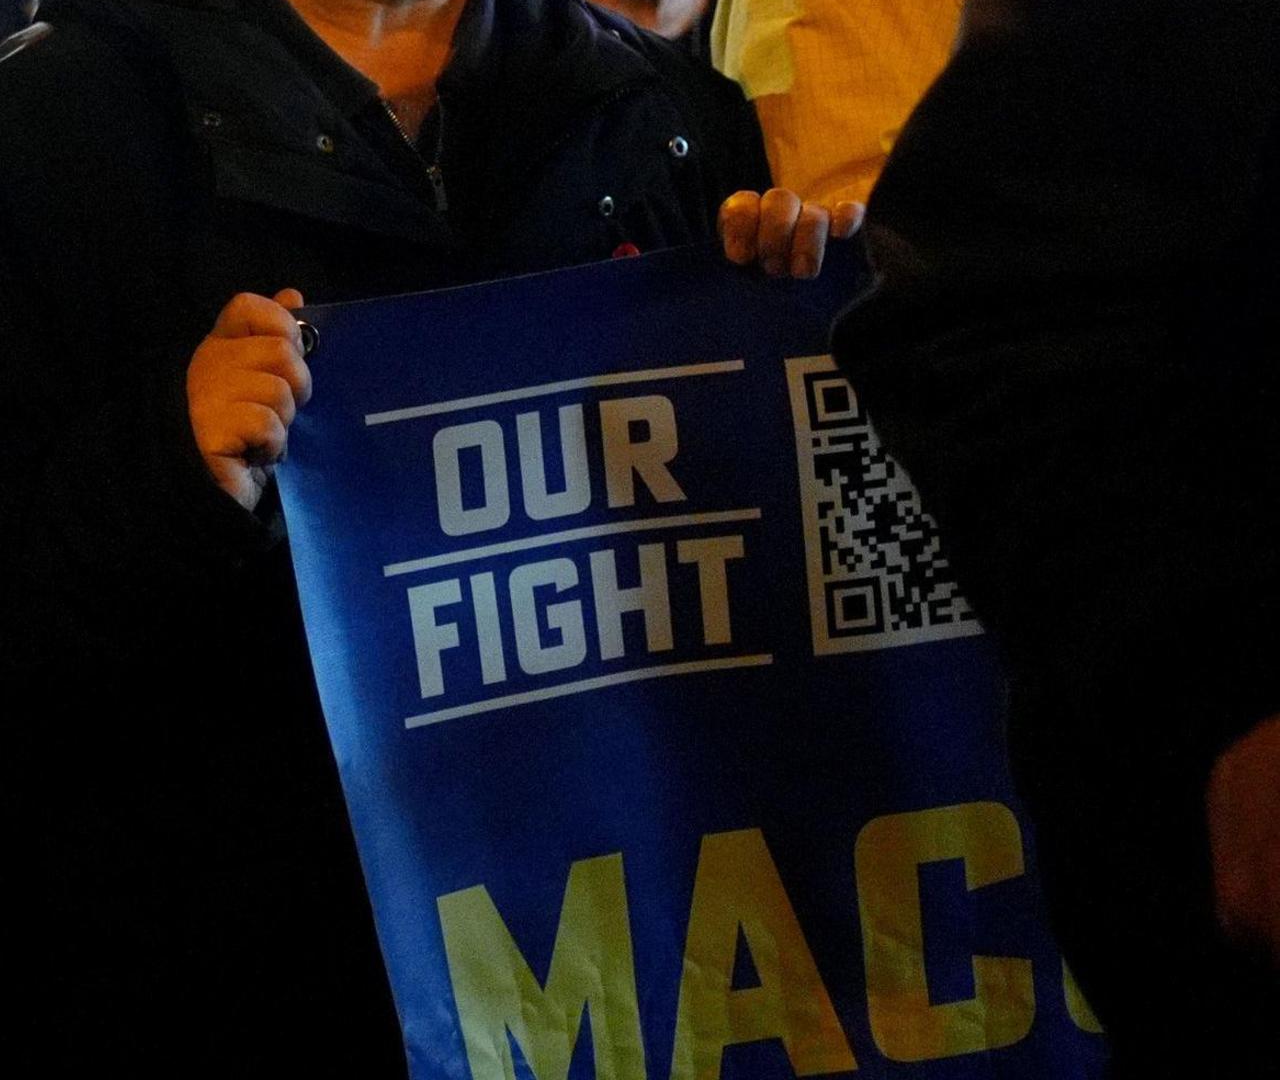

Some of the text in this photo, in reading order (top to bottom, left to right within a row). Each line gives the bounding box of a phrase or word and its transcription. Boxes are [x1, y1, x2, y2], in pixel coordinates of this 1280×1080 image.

[432, 394, 688, 538] OUR
[406, 534, 745, 699] FIGHT
[436, 800, 1104, 1080] MAC
